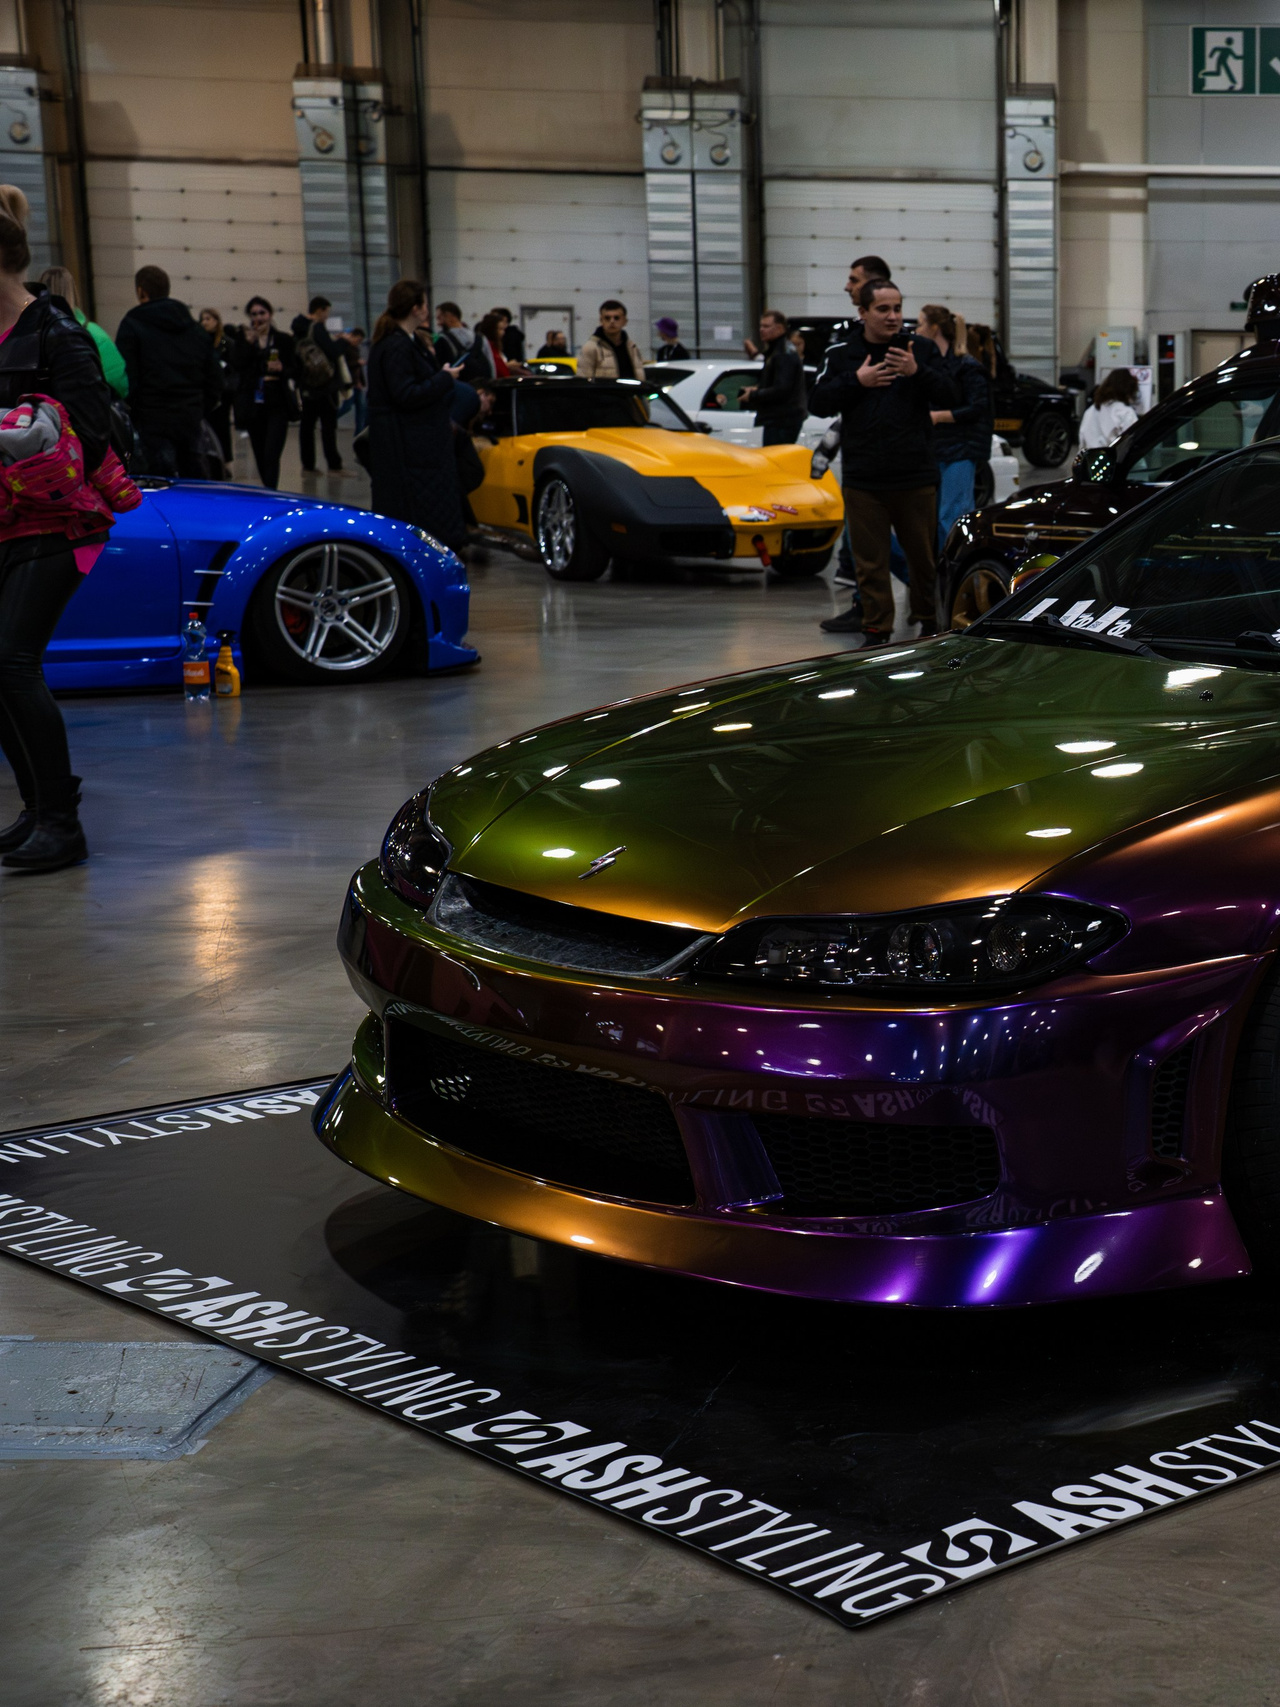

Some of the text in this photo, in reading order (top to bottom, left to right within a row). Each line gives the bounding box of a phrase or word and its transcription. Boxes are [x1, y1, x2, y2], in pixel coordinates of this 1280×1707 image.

[194, 1089, 321, 1125] ASH
[157, 1291, 325, 1341] ASH
[254, 1326, 501, 1421] STYLING
[516, 1441, 711, 1510] ASH
[641, 1489, 946, 1618] STYLING
[1011, 1464, 1200, 1541] ASH
